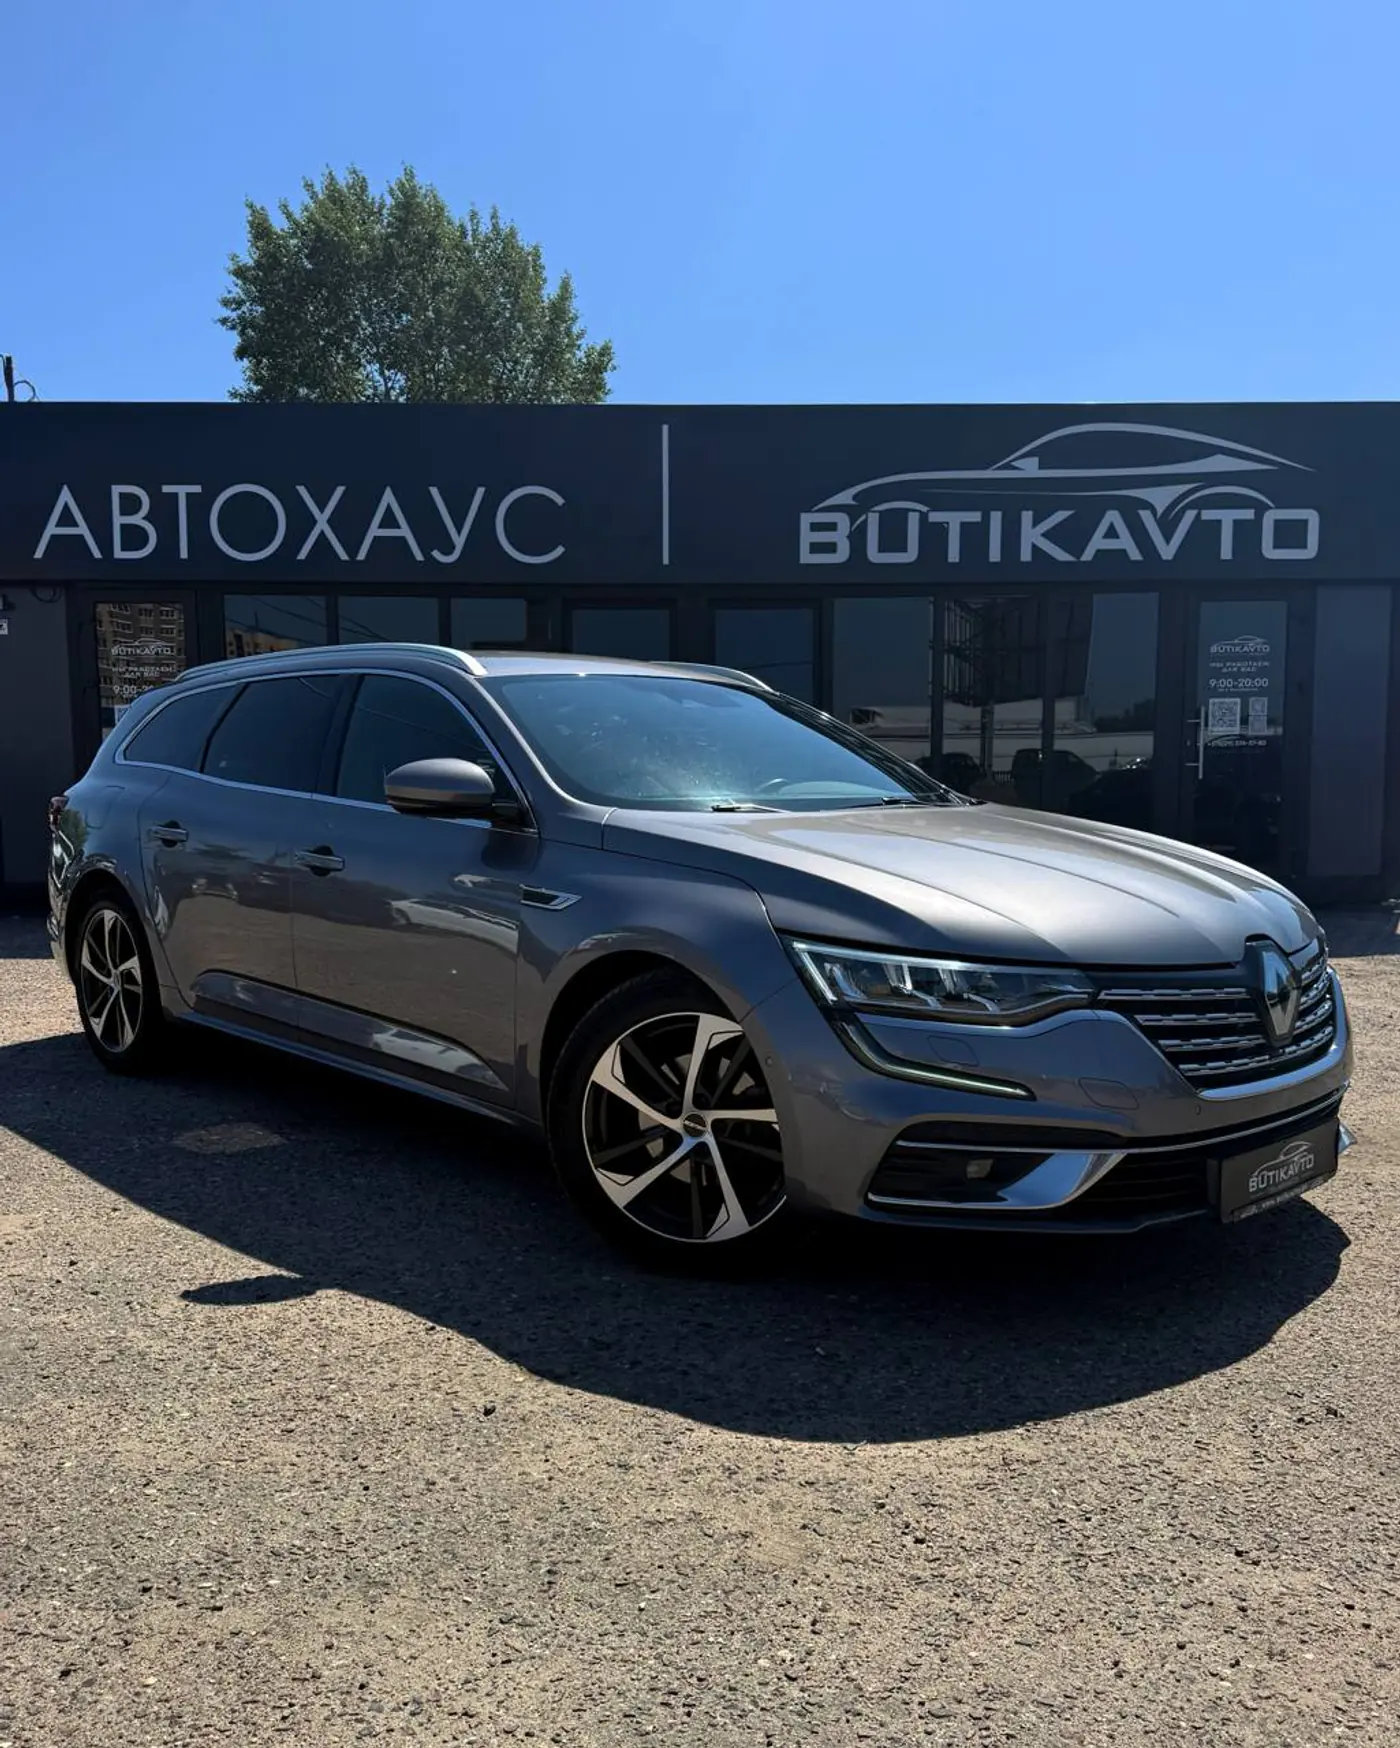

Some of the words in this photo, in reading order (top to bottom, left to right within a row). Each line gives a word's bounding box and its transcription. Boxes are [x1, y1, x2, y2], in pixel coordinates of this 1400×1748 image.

[33, 484, 566, 565] АВТОХАУС
[799, 508, 1320, 564] BUTIKAVTO
[1209, 645, 1271, 653] BUTIKAVTO
[1209, 678, 1269, 688] 9:00-20:00
[1248, 1154, 1315, 1193] BUTIKAVTO
